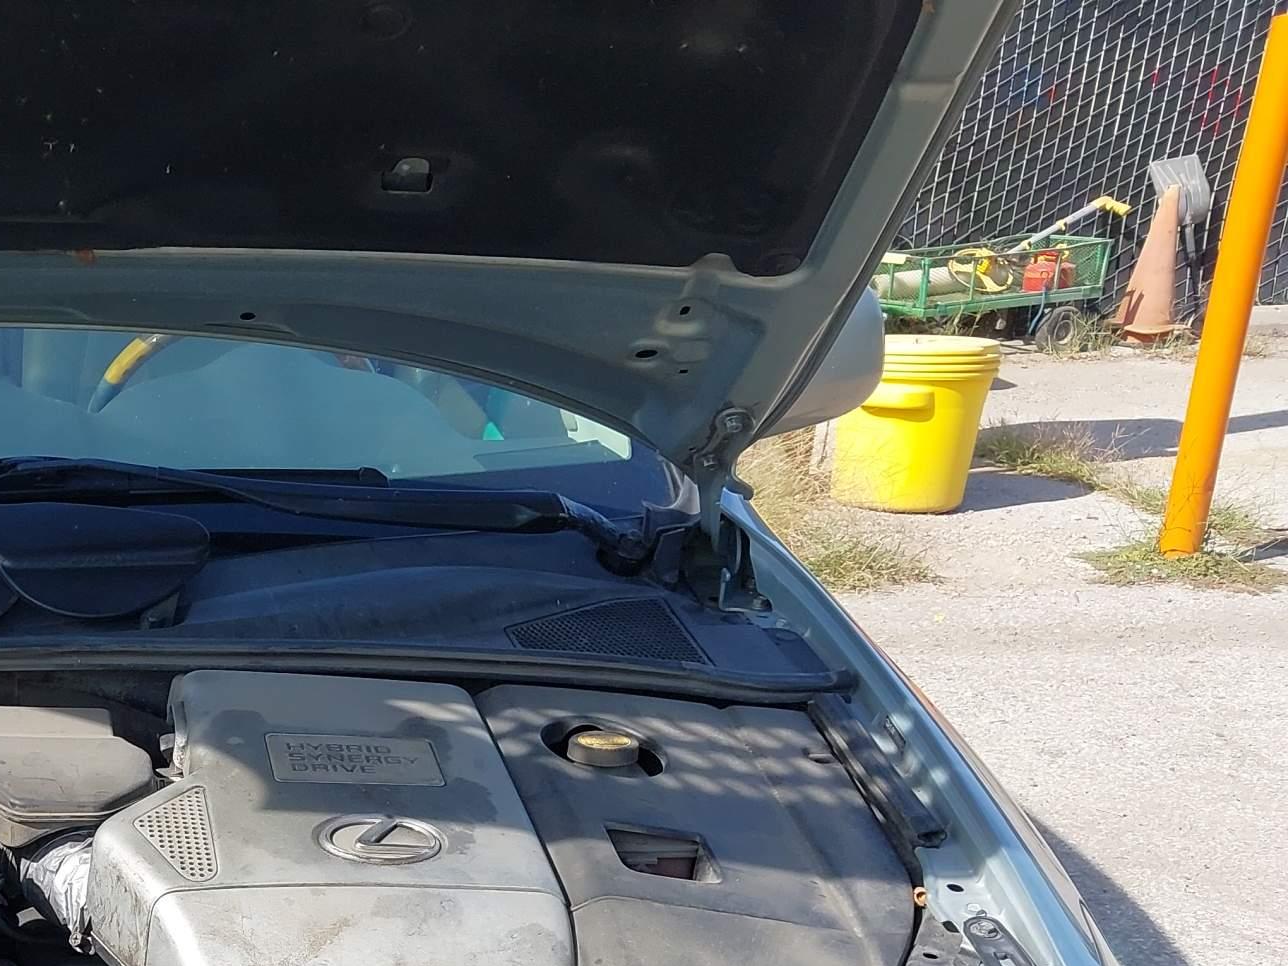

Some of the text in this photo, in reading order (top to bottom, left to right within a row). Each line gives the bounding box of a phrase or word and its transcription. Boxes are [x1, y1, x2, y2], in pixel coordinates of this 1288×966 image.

[286, 742, 391, 754] HYBRID
[288, 752, 418, 765] SYNERGY
[292, 762, 376, 774] DRIVE
